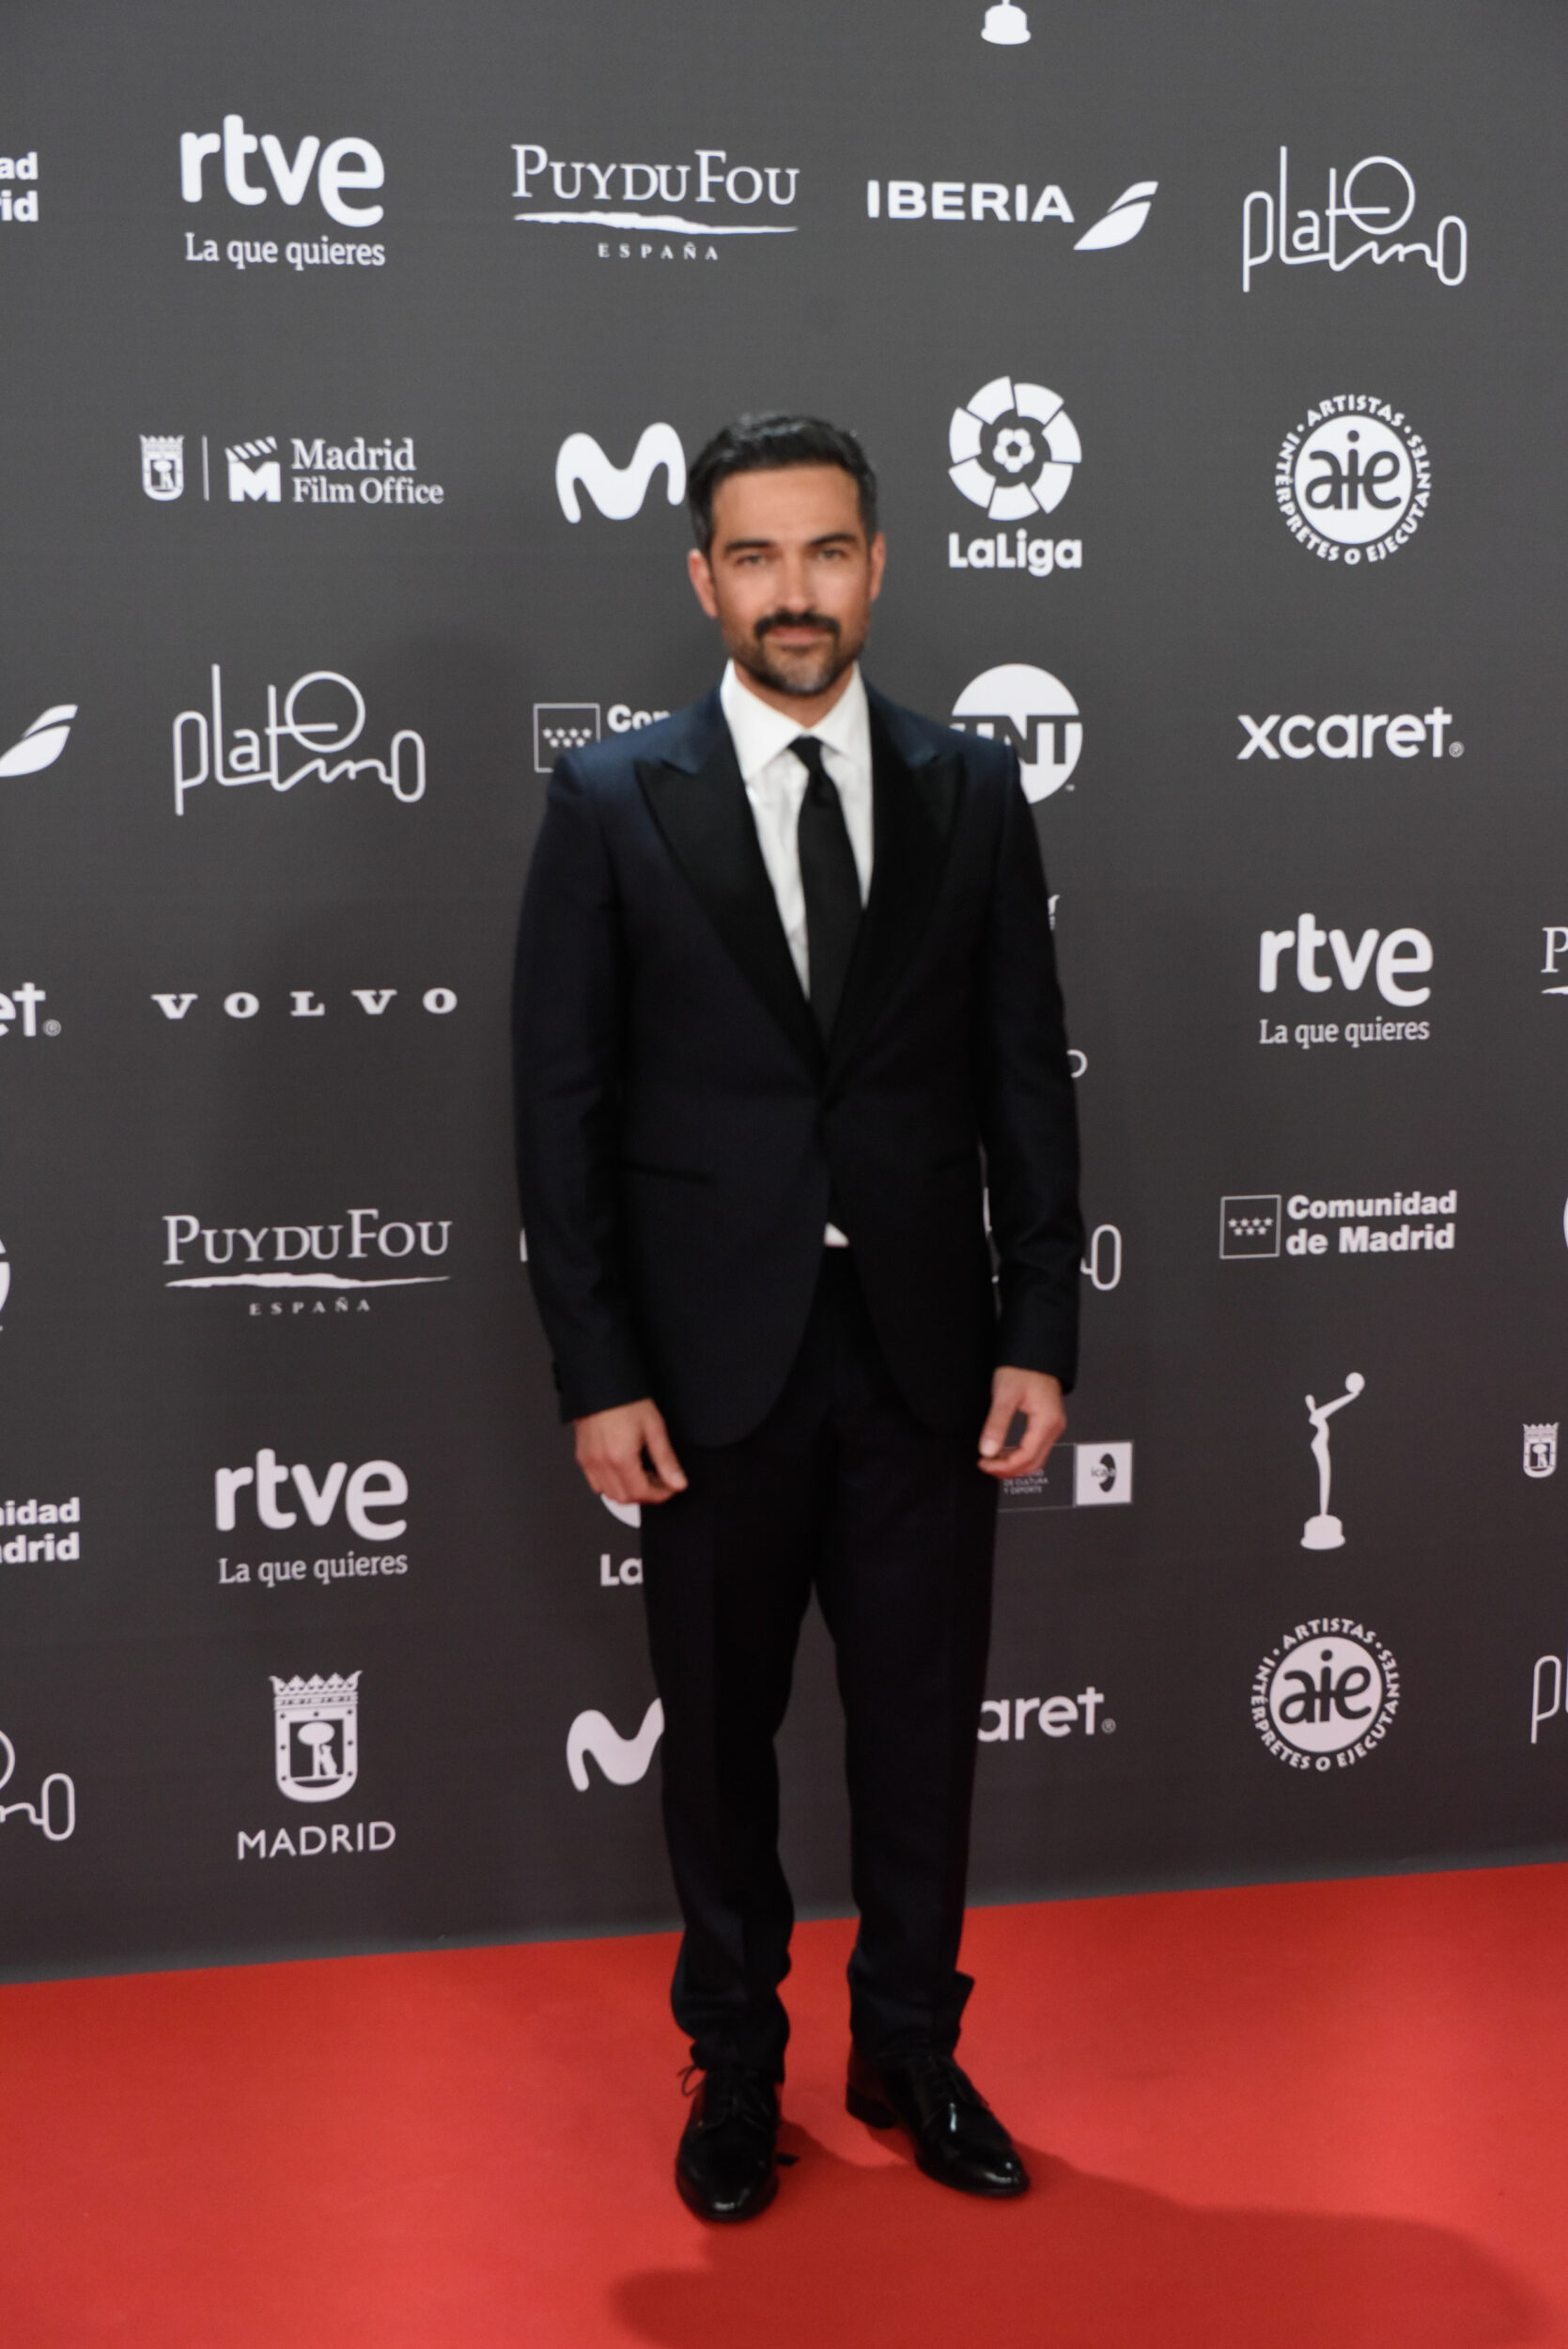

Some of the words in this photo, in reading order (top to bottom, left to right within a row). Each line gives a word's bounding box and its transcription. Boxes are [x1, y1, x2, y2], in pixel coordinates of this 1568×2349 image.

[180, 115, 385, 227] rtve
[867, 179, 1075, 224] IBERIA
[185, 232, 220, 262] La
[227, 241, 278, 271] que
[286, 236, 386, 272] quieres
[598, 242, 719, 260] ESPAÑA
[1307, 394, 1405, 428] ARTISTAS
[291, 438, 417, 472] Madrid
[1305, 429, 1402, 510] aie
[293, 476, 356, 504] Film
[359, 476, 444, 505] Office
[1343, 547, 1361, 566] O
[1366, 434, 1432, 563] EJECUTANTES
[948, 529, 1082, 577] LaLiga
[1259, 912, 1434, 1007] rtve
[151, 988, 458, 1019] VOLVO
[1260, 1019, 1289, 1045] La
[1295, 1023, 1339, 1050] que
[1343, 1016, 1430, 1049] quieres
[1286, 1190, 1457, 1220] Comunidad
[1286, 1228, 1328, 1255] de
[1339, 1222, 1454, 1253] Madrid
[249, 1298, 370, 1315] ESPAÑA
[215, 1449, 409, 1541] rtve
[0, 1532, 80, 1563] drid
[218, 1558, 251, 1584] La
[258, 1560, 306, 1589] que
[314, 1551, 409, 1585] quieres
[1282, 1617, 1376, 1650] ARTISTAS
[1279, 1649, 1372, 1724] aie
[1315, 1756, 1331, 1772] O
[1336, 1649, 1401, 1768] EJECUTANTES
[238, 1821, 396, 1860] MADRID
